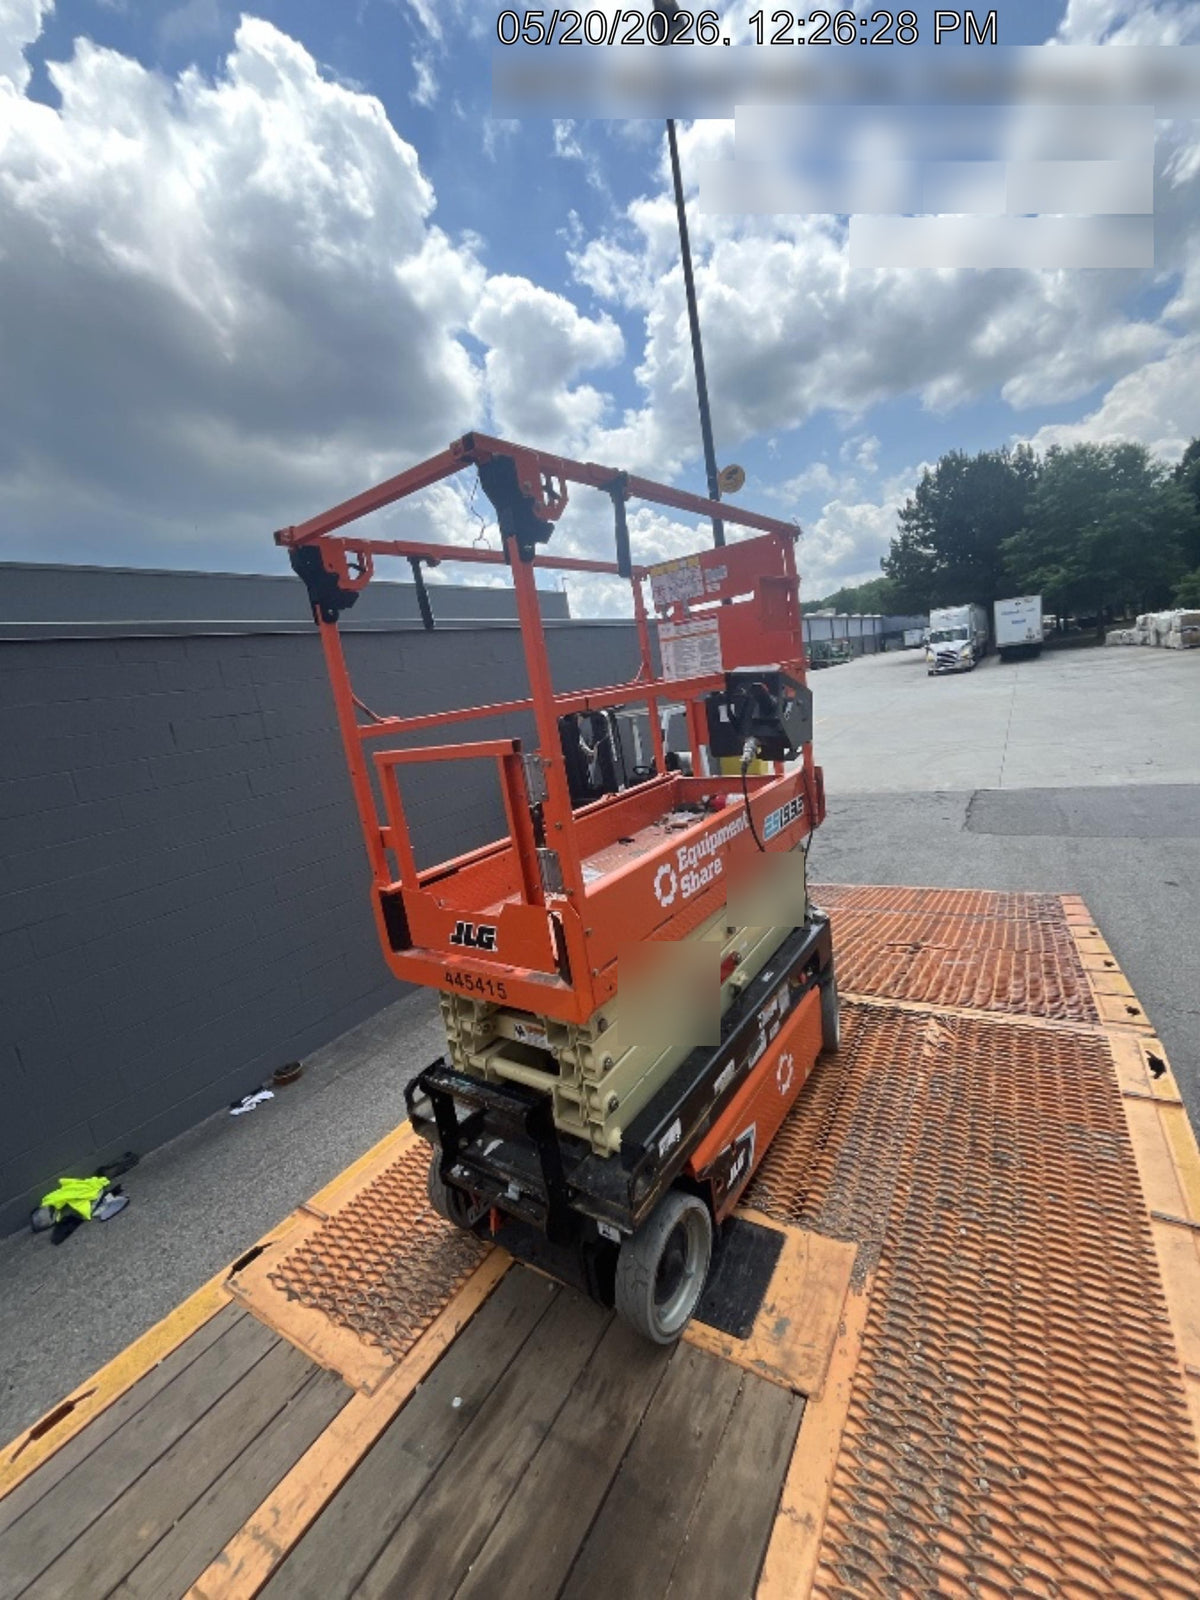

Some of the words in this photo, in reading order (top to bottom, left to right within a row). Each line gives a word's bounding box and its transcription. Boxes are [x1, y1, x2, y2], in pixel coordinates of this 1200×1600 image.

[676, 810, 750, 873] Equipment
[680, 858, 723, 899] Share
[450, 920, 498, 951] JLG
[445, 972, 507, 1000] 445415
